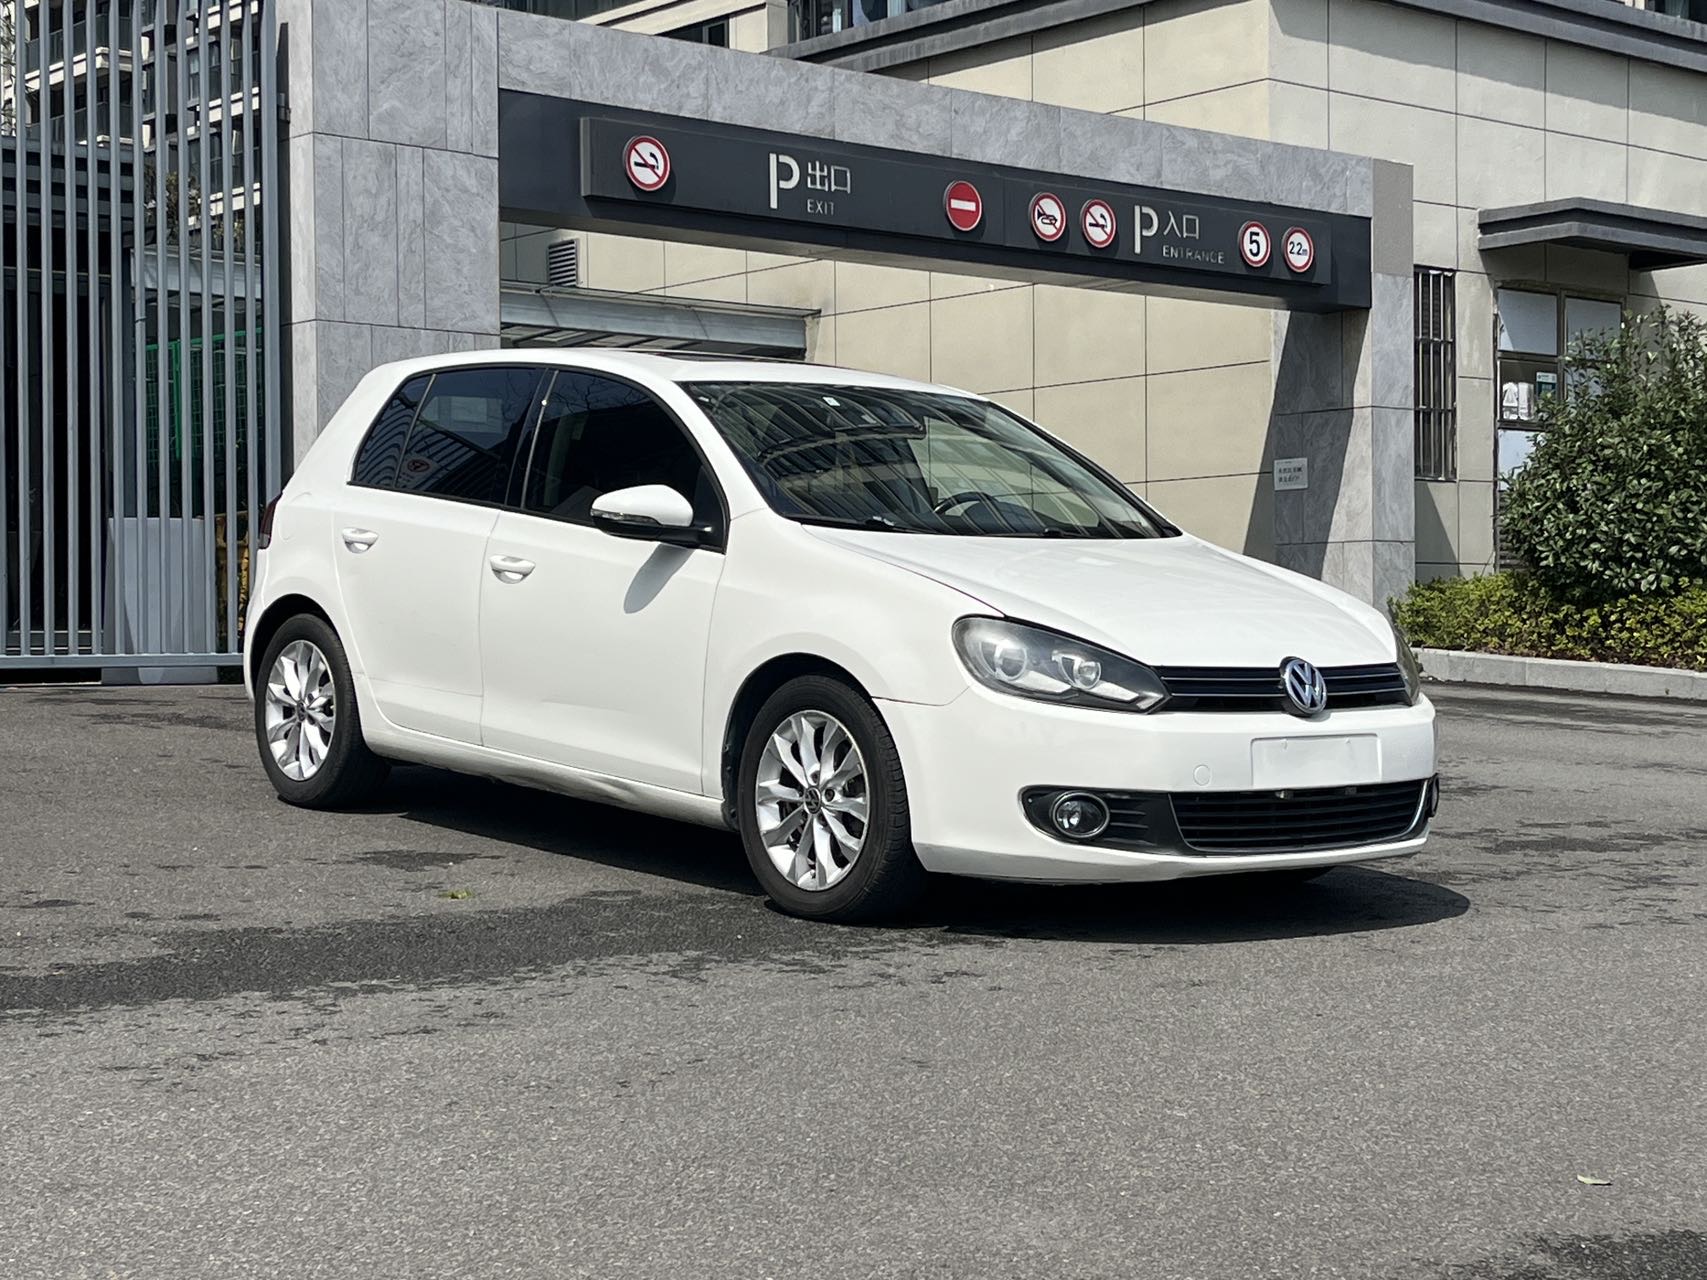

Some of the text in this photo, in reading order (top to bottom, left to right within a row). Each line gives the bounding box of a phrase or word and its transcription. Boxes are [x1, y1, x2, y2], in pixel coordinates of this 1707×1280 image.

[769, 152, 800, 209] P
[807, 161, 850, 193] 出口
[807, 199, 834, 215] EXIT
[1134, 205, 1159, 254] P
[1163, 210, 1199, 240] 入口
[1162, 244, 1225, 264] ENTRANCE
[1249, 231, 1261, 257] 5
